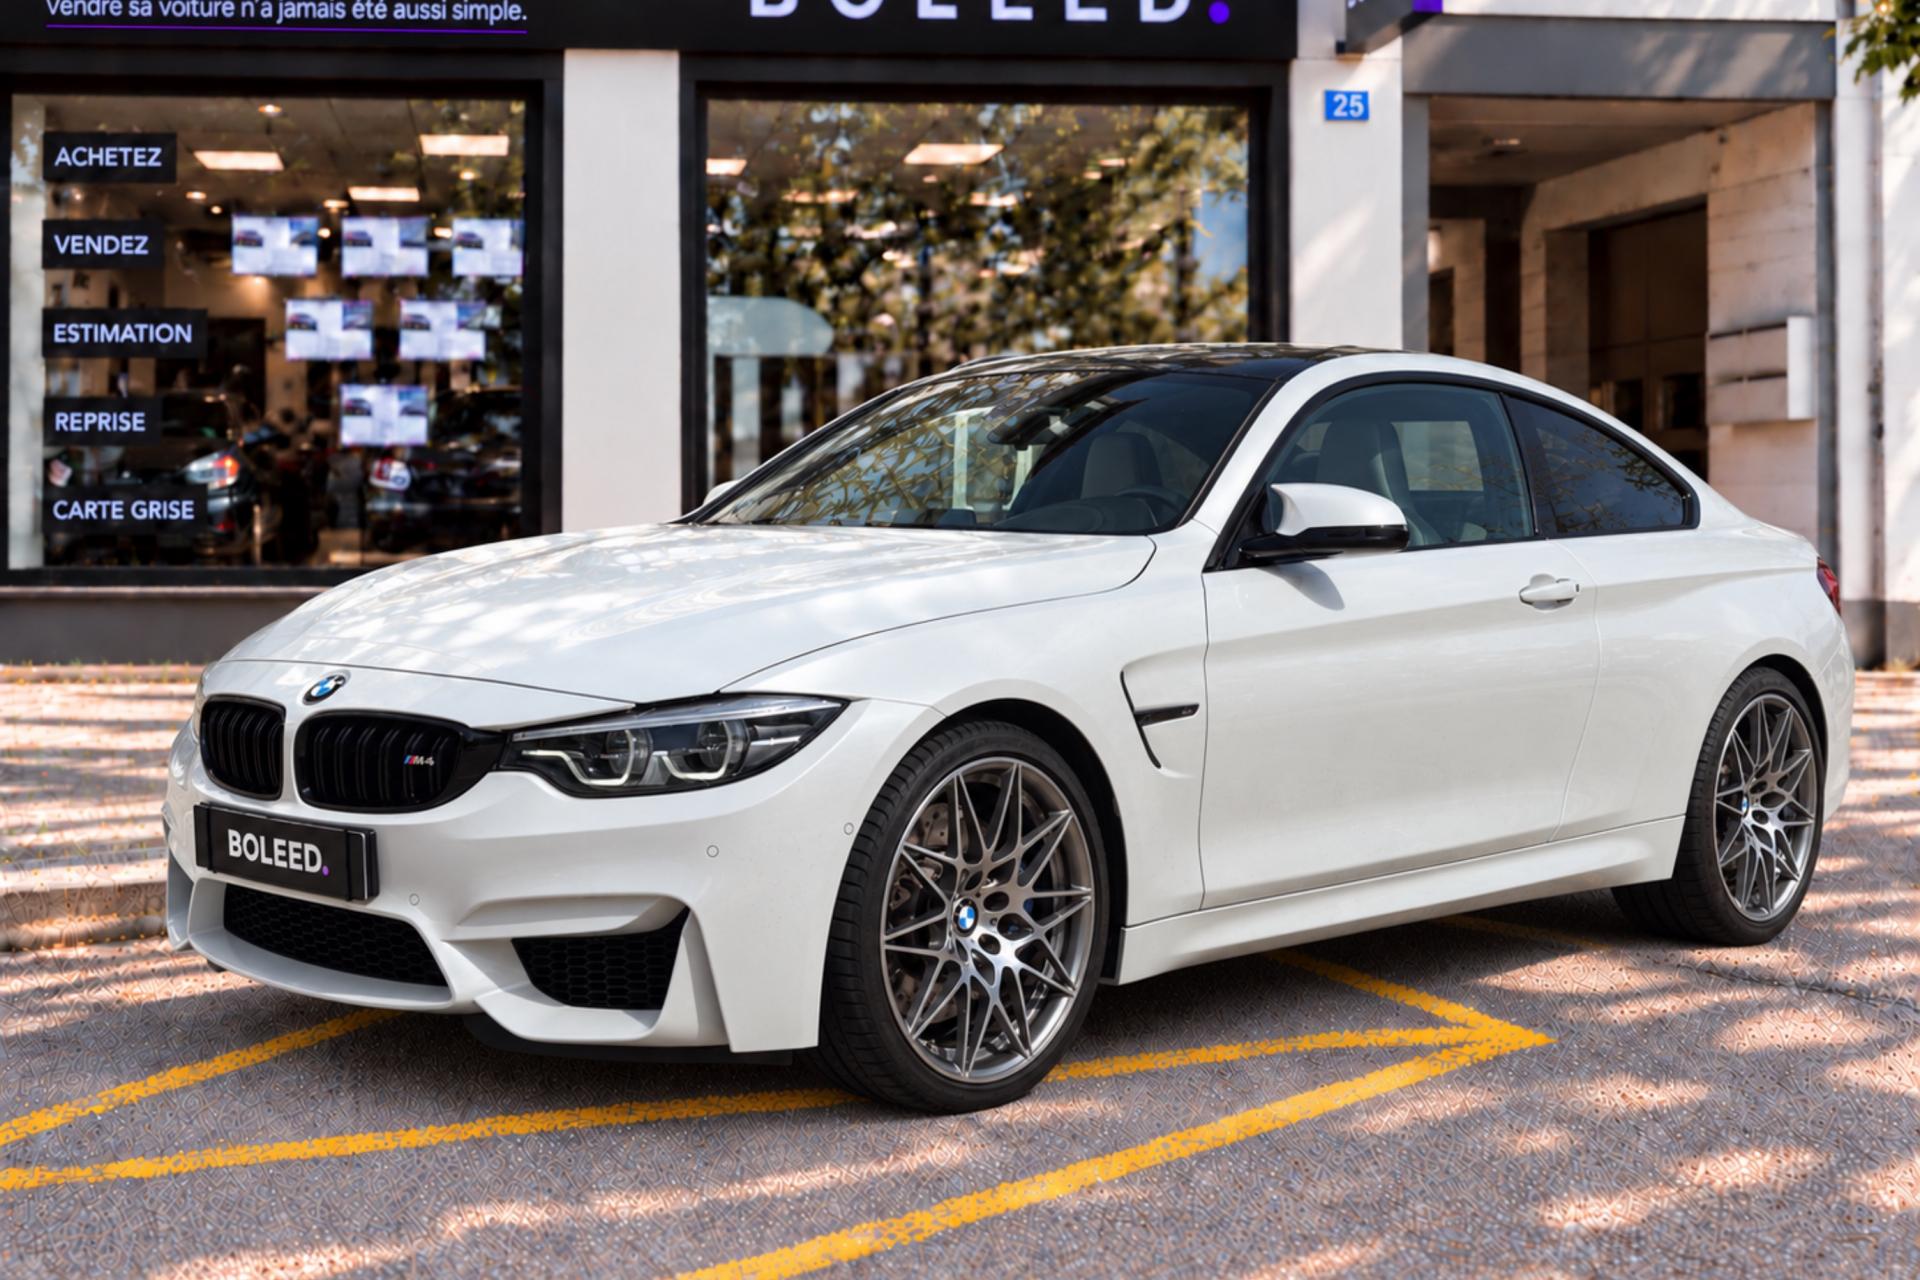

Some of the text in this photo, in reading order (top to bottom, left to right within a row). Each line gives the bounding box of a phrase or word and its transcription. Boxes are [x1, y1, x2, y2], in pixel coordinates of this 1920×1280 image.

[46, 0, 123, 17] Vendre
[128, 0, 153, 17] sa
[158, 0, 236, 18] voiture
[276, 0, 347, 24] jamais
[351, 0, 388, 20] été
[392, 0, 447, 20] aussi
[452, 0, 527, 26] simple.
[1333, 94, 1364, 117] 25
[54, 147, 162, 167] ACHETEZ
[54, 235, 149, 255] VENDEZ
[53, 323, 192, 344] ESTIMATION
[54, 412, 146, 432] REPRISE
[53, 500, 195, 520] CARTE GRISE
[228, 829, 329, 876] BOLEED.
